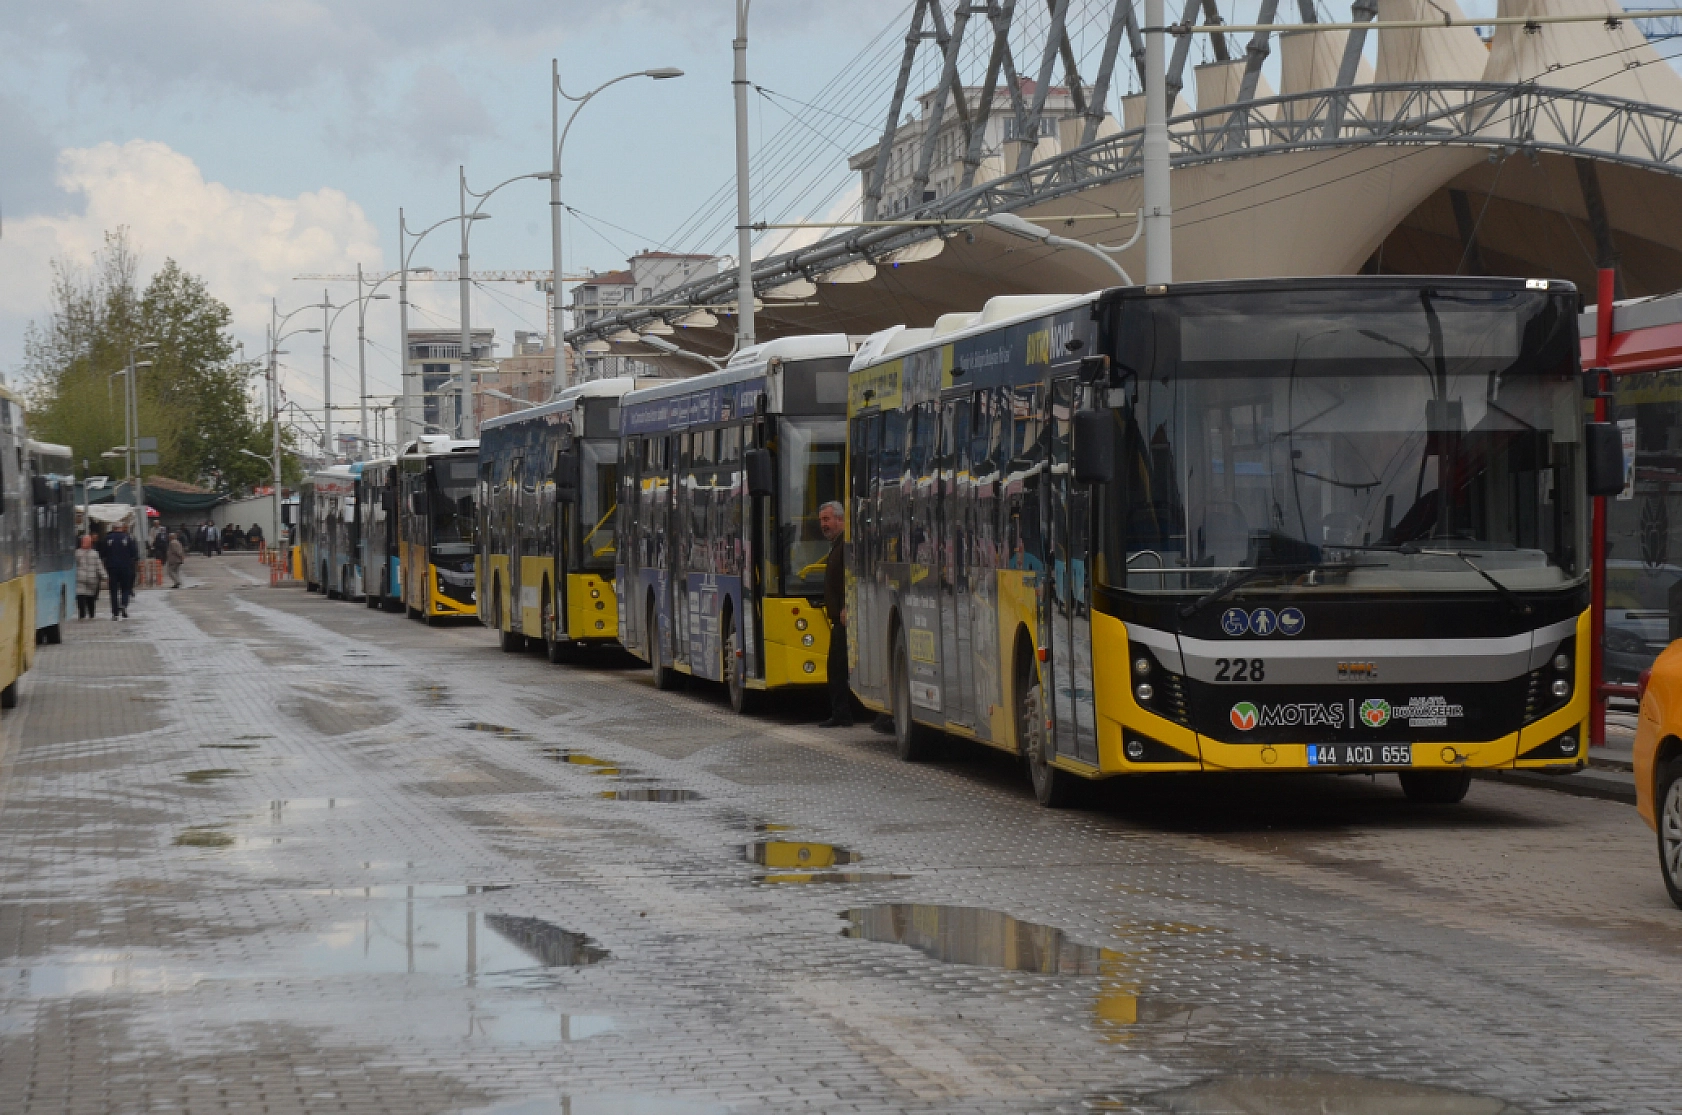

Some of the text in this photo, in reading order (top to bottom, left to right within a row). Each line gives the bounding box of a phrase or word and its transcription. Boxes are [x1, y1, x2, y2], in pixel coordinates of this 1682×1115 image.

[1214, 658, 1265, 682] 228
[1337, 661, 1378, 681] BMC
[1261, 703, 1345, 729] MOTAŞ
[1318, 746, 1337, 764] 44
[1346, 746, 1373, 764] ACD
[1382, 745, 1410, 764] 655
